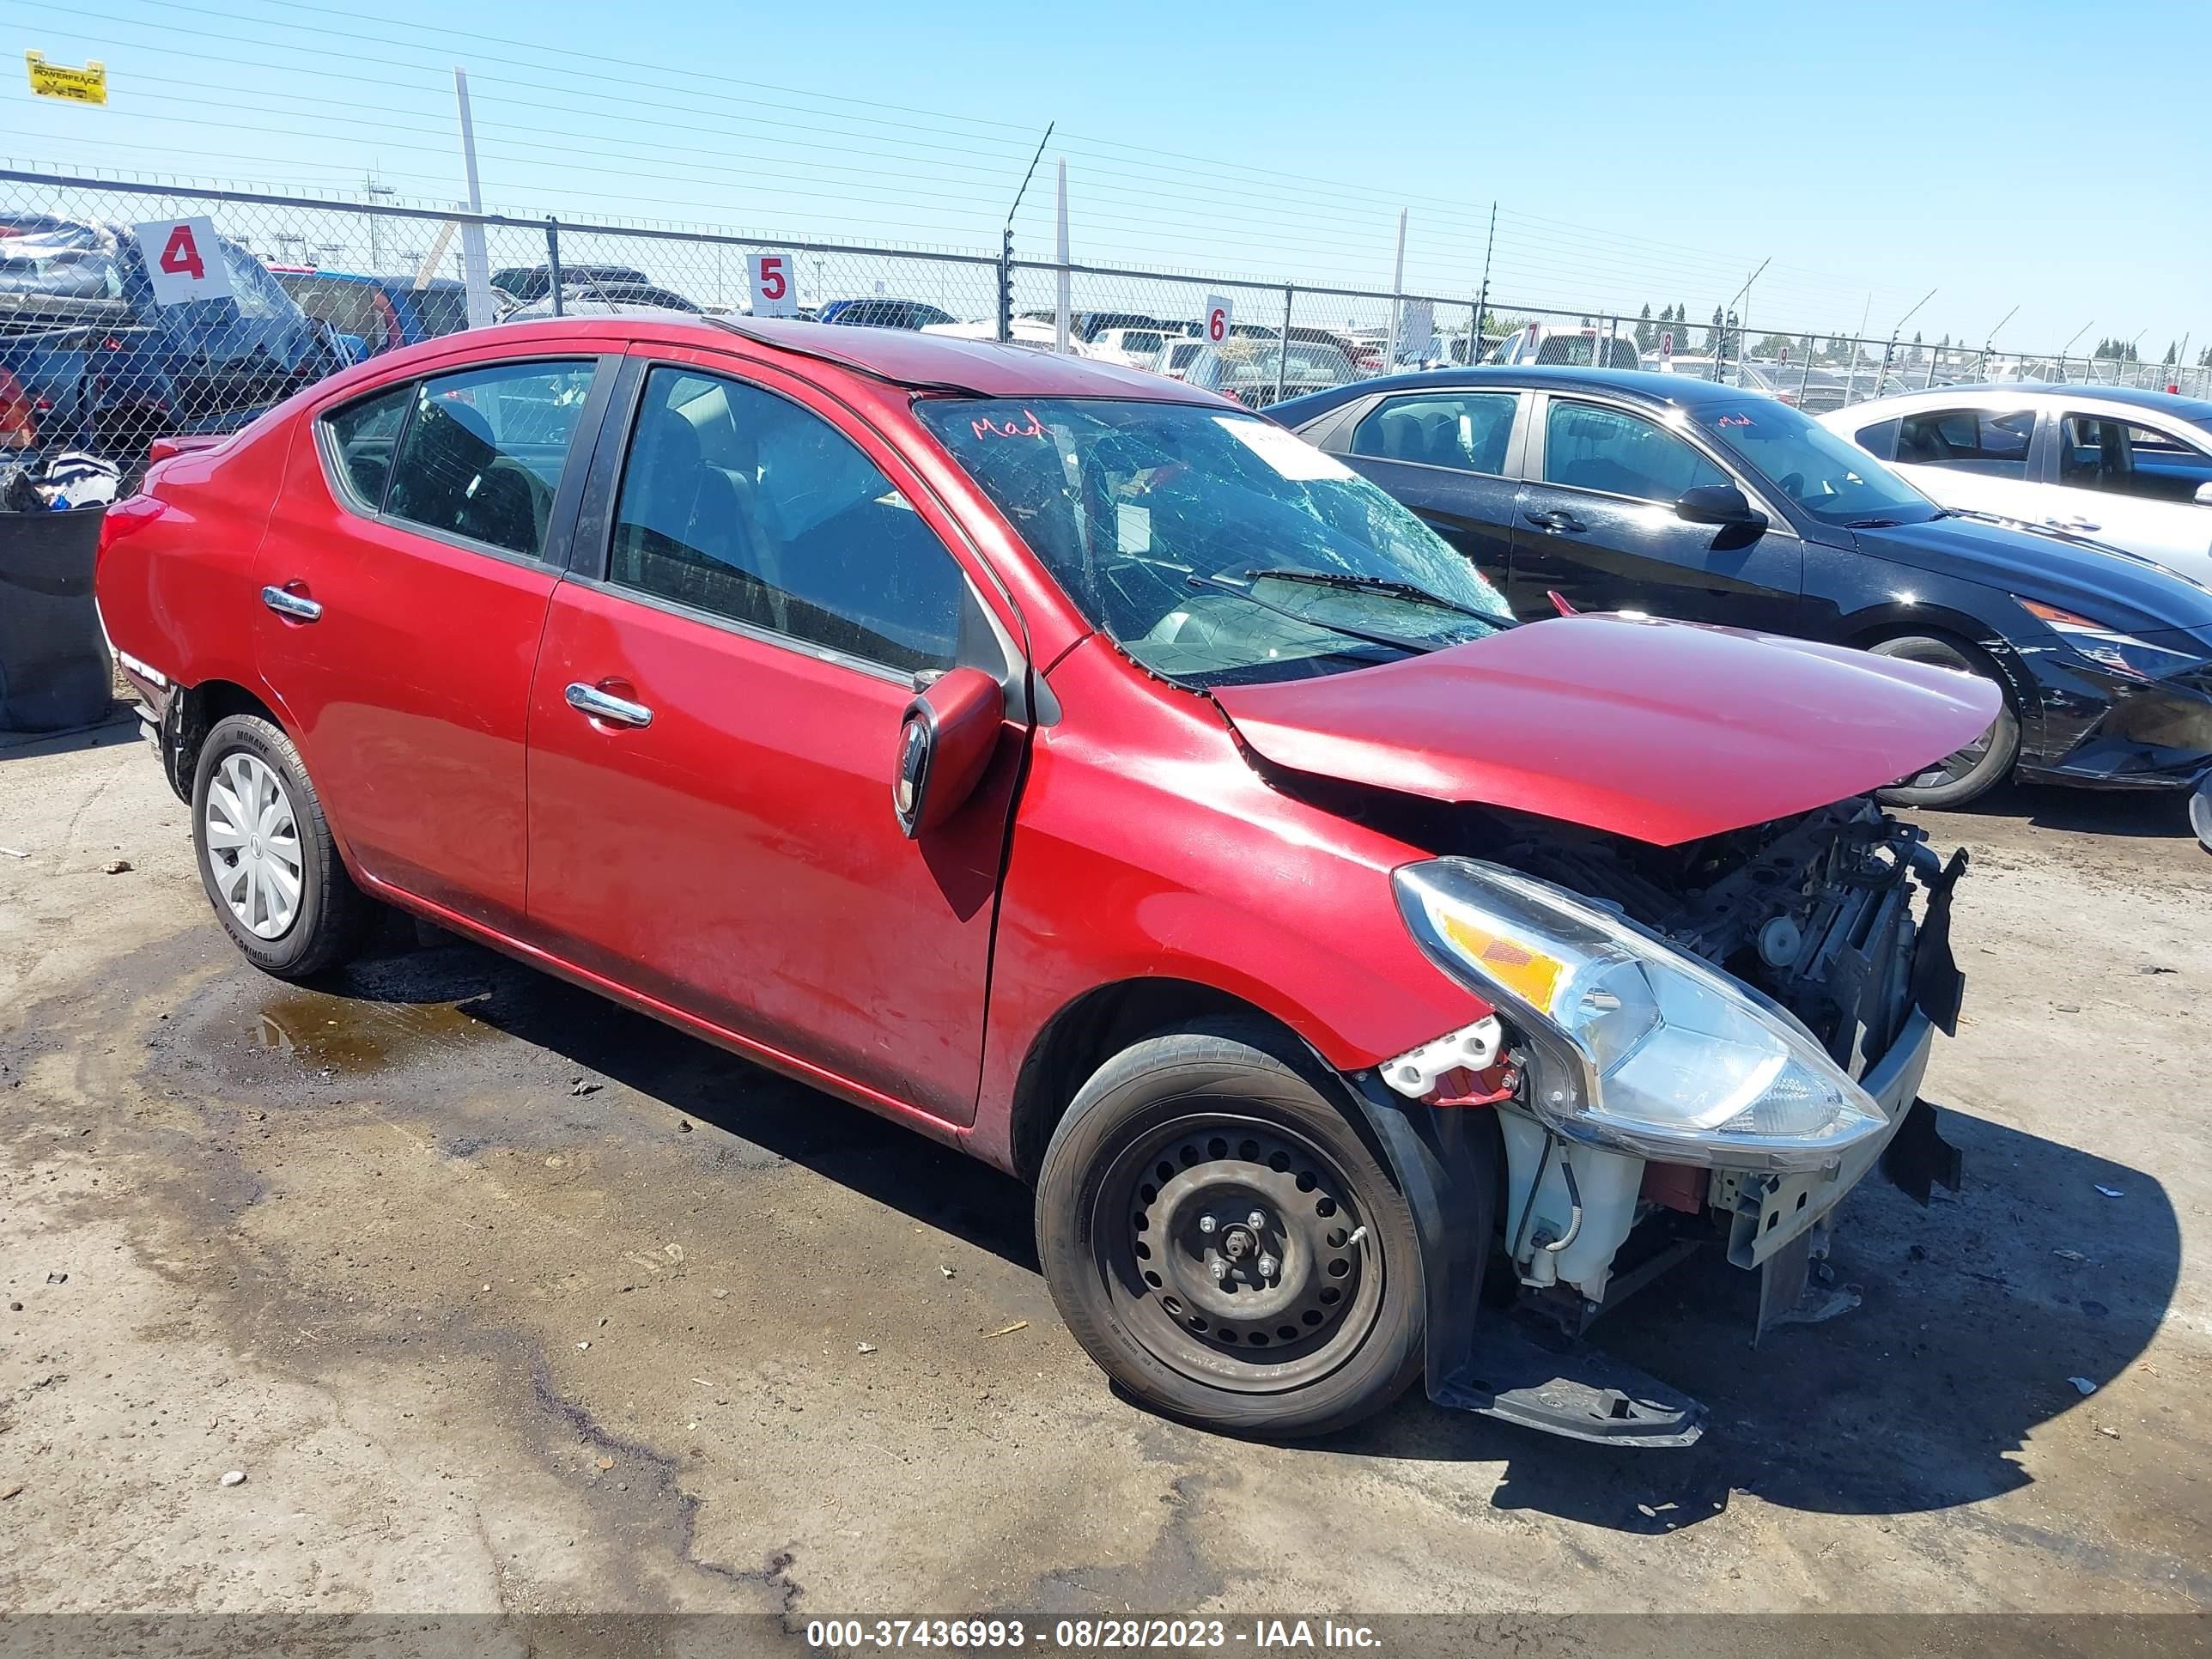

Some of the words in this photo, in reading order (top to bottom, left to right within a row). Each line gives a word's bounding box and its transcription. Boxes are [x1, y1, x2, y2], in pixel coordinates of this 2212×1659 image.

[161, 226, 204, 280] 4
[761, 258, 786, 300] 5
[1210, 308, 1224, 341] 6
[1528, 323, 1538, 348] 7
[1663, 333, 1672, 356] 8
[1781, 348, 1787, 367] 9
[239, 939, 274, 963] TOURING
